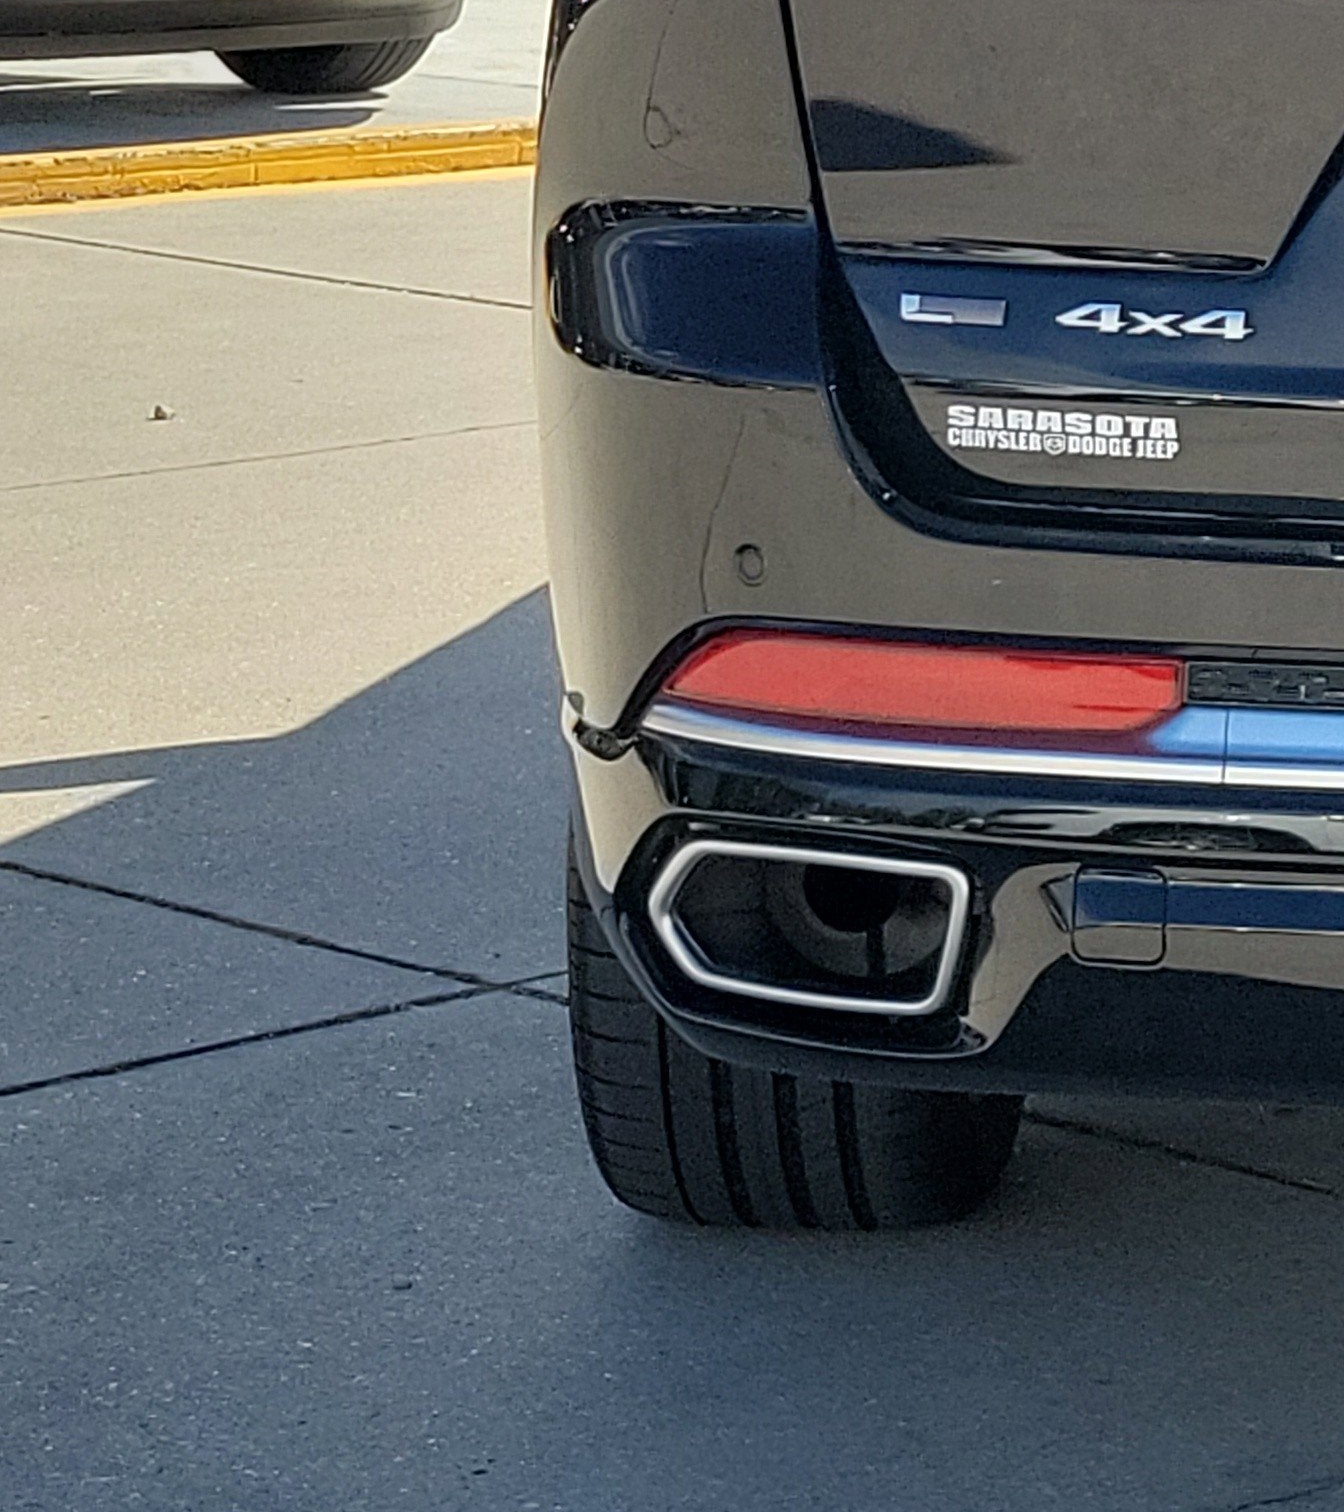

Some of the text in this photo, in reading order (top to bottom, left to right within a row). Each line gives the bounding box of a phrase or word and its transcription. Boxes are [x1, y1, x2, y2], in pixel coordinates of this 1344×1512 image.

[1055, 302, 1255, 340] 4x4
[947, 405, 1178, 439] SARASOTA
[947, 428, 1180, 460] CHRYSLER DODGE JEEP
